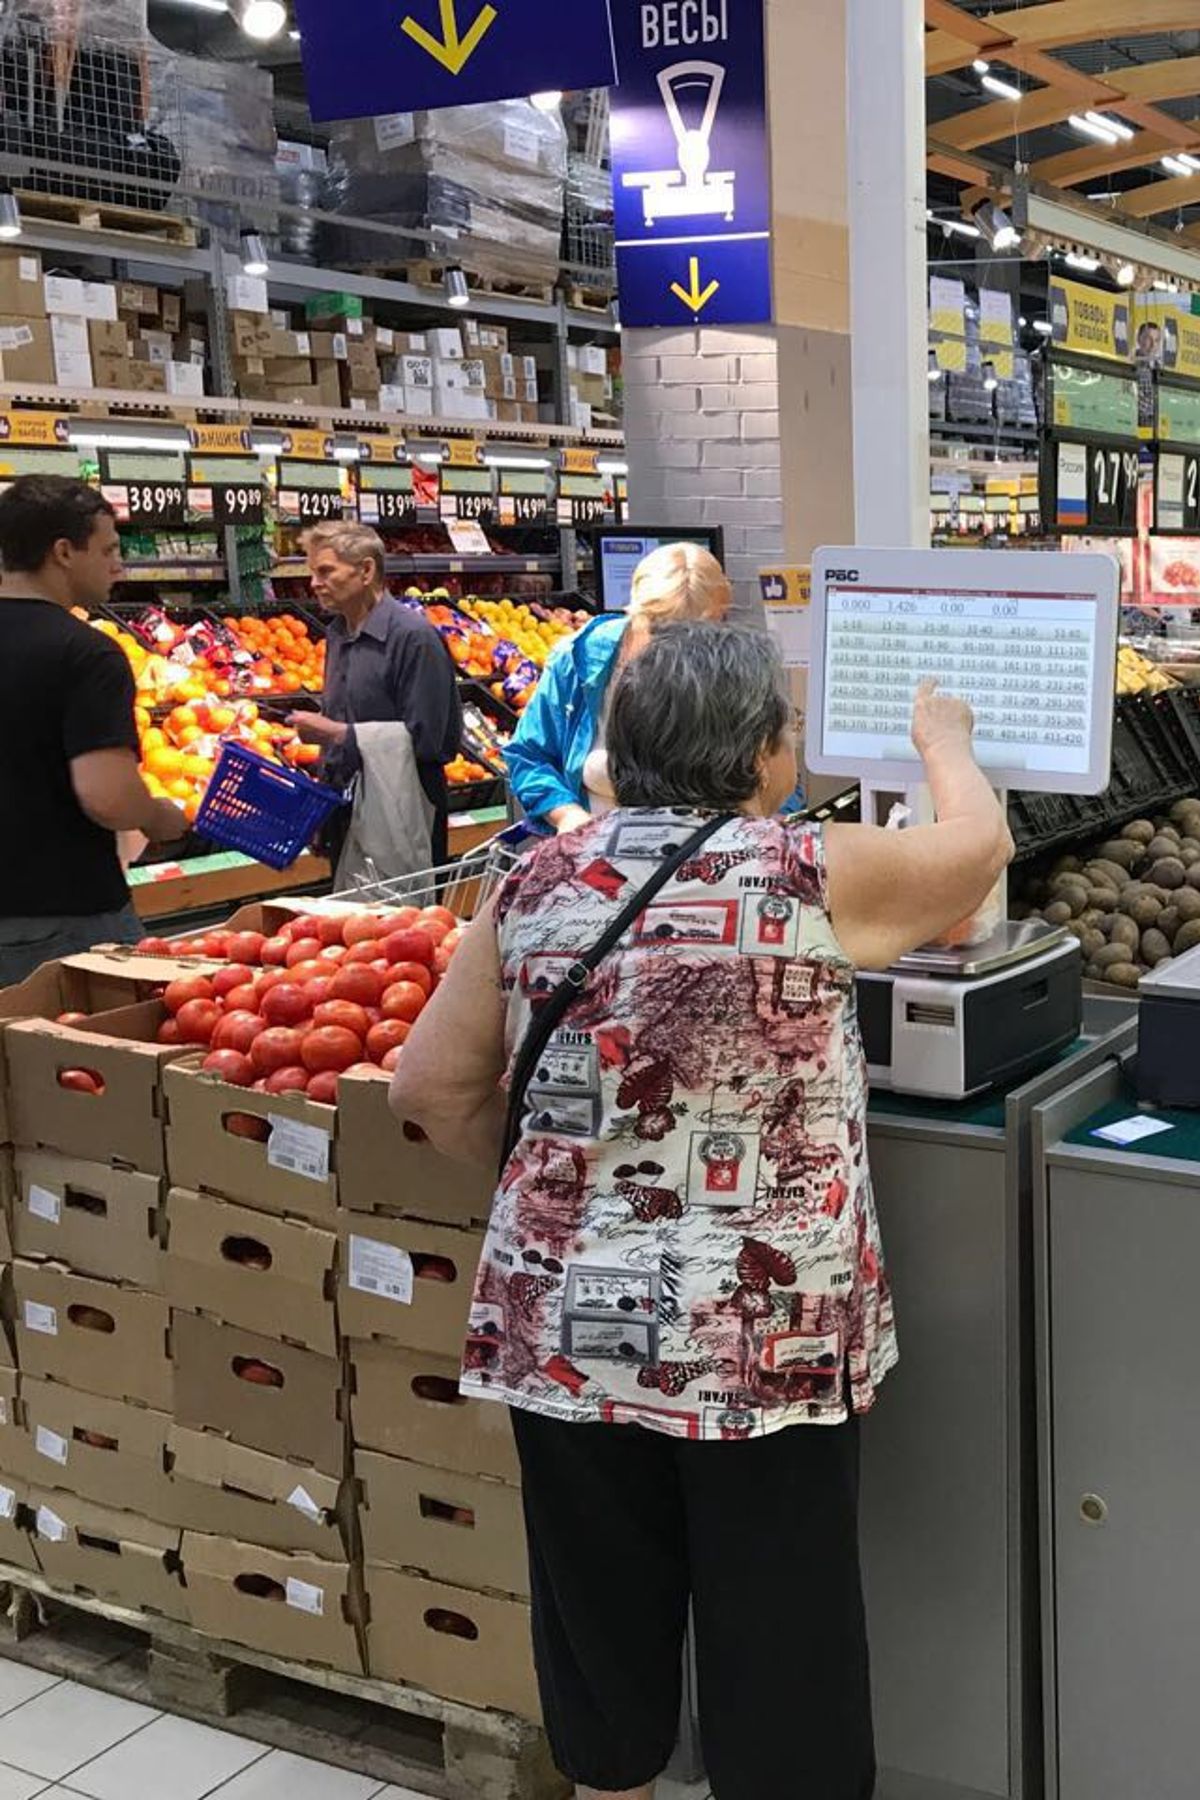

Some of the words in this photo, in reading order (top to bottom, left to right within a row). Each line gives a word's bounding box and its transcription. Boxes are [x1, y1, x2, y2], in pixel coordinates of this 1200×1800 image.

[641, 0, 728, 48] ВЕСЫ
[1094, 450, 1120, 504] 27
[765, 1185, 805, 1199] SAFARI
